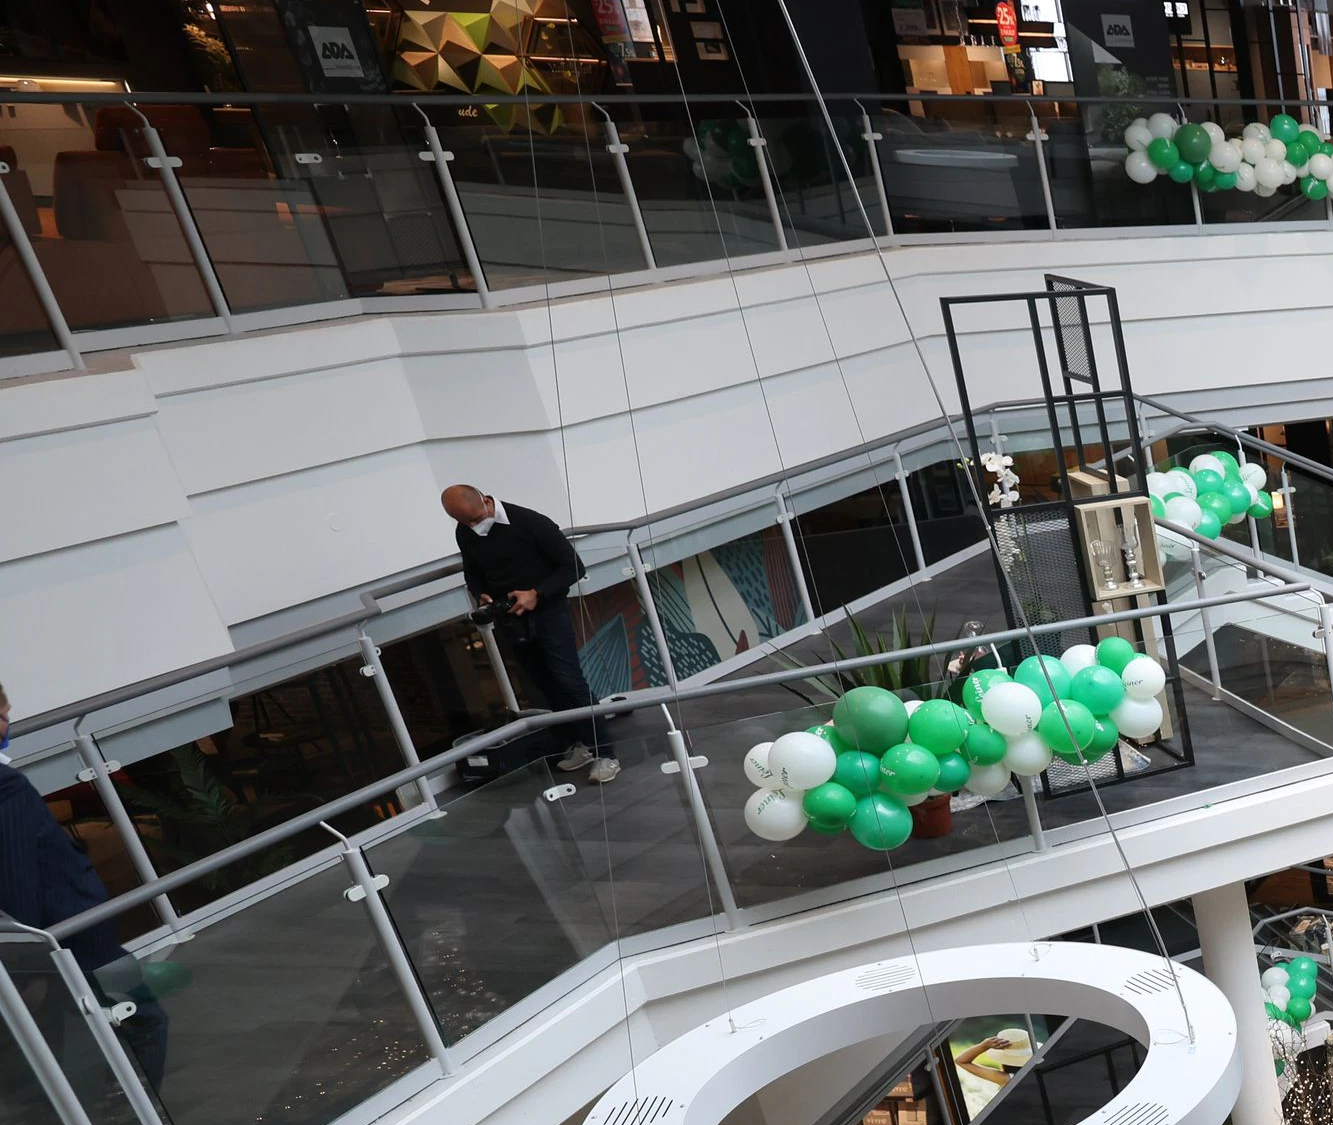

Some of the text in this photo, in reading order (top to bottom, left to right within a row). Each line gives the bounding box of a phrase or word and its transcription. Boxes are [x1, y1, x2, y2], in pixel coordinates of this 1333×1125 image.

[1106, 24, 1131, 36] ADA
[321, 41, 355, 60] ADA
[756, 788, 786, 815] Leiner
[866, 1115, 888, 1125] vivre
